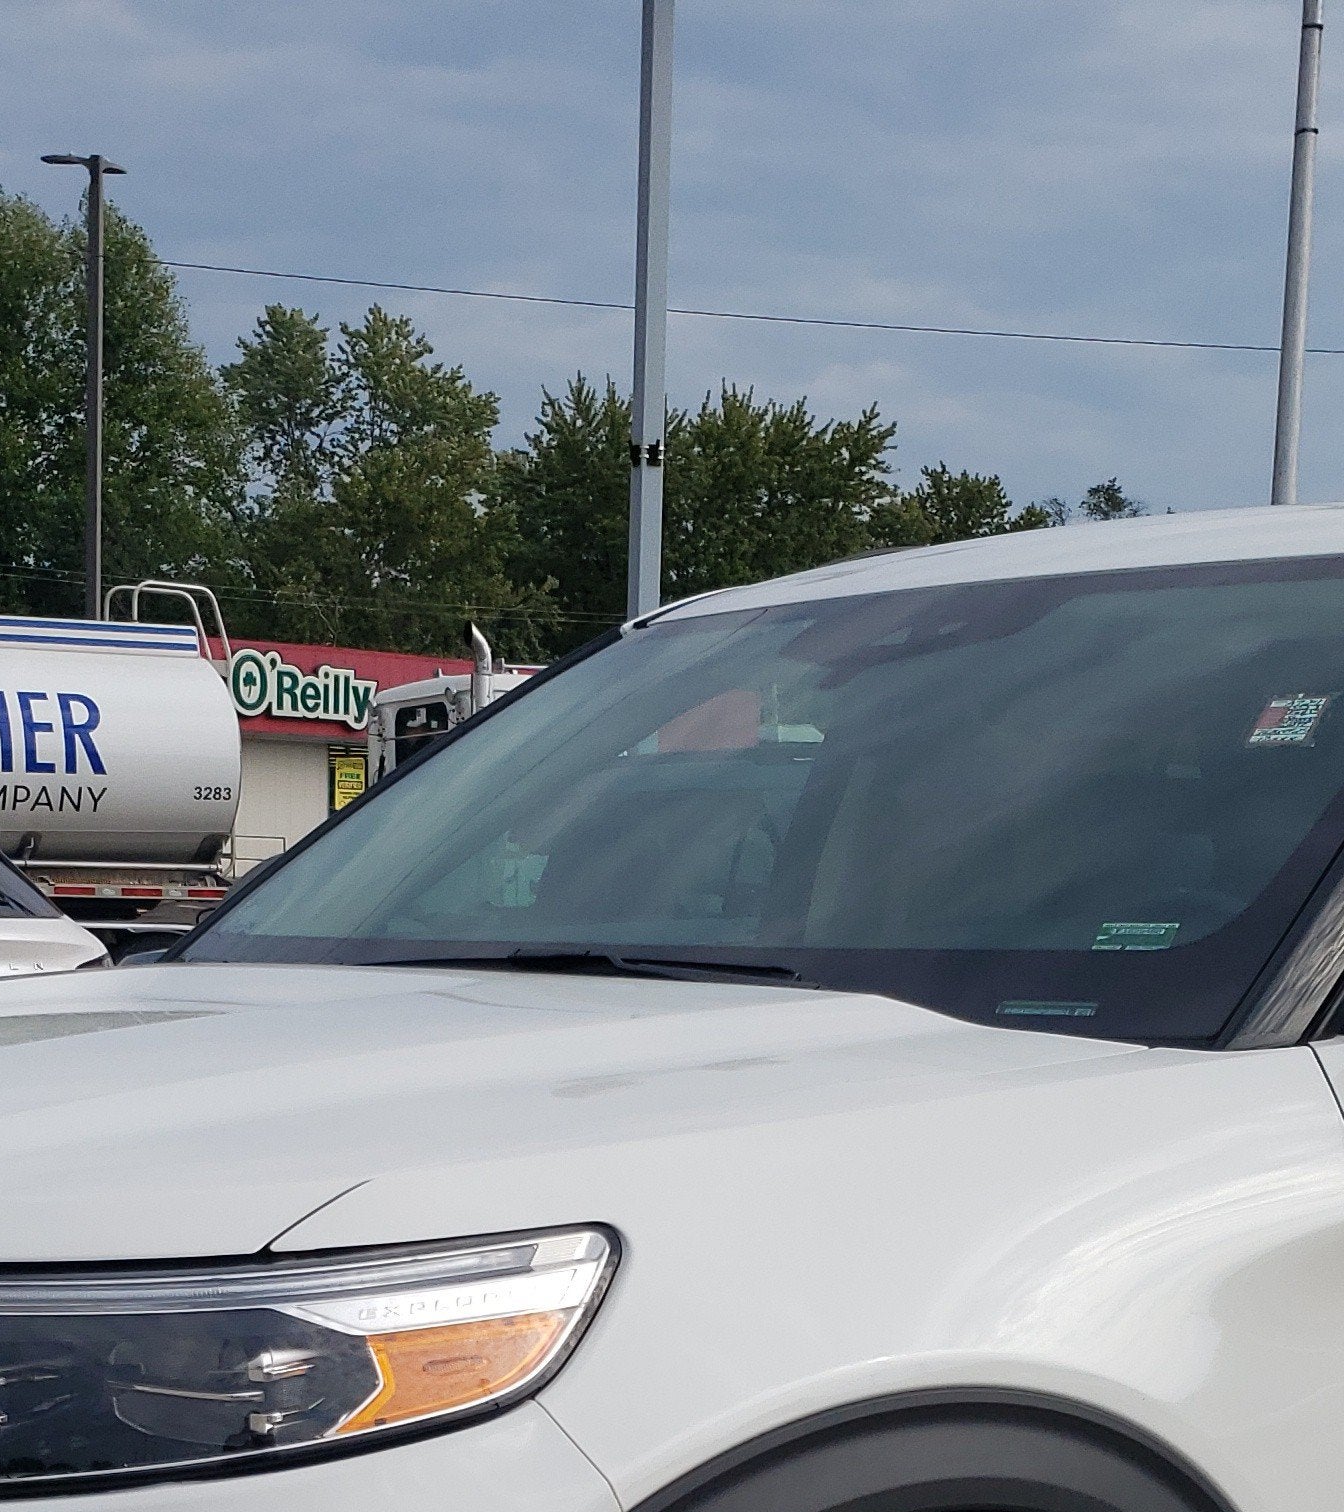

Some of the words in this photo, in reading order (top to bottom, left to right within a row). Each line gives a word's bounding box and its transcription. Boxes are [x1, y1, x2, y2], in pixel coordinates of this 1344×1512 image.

[232, 654, 372, 724] O'Reilly
[193, 786, 232, 801] 3283
[358, 1284, 538, 1322] EXPLOR
